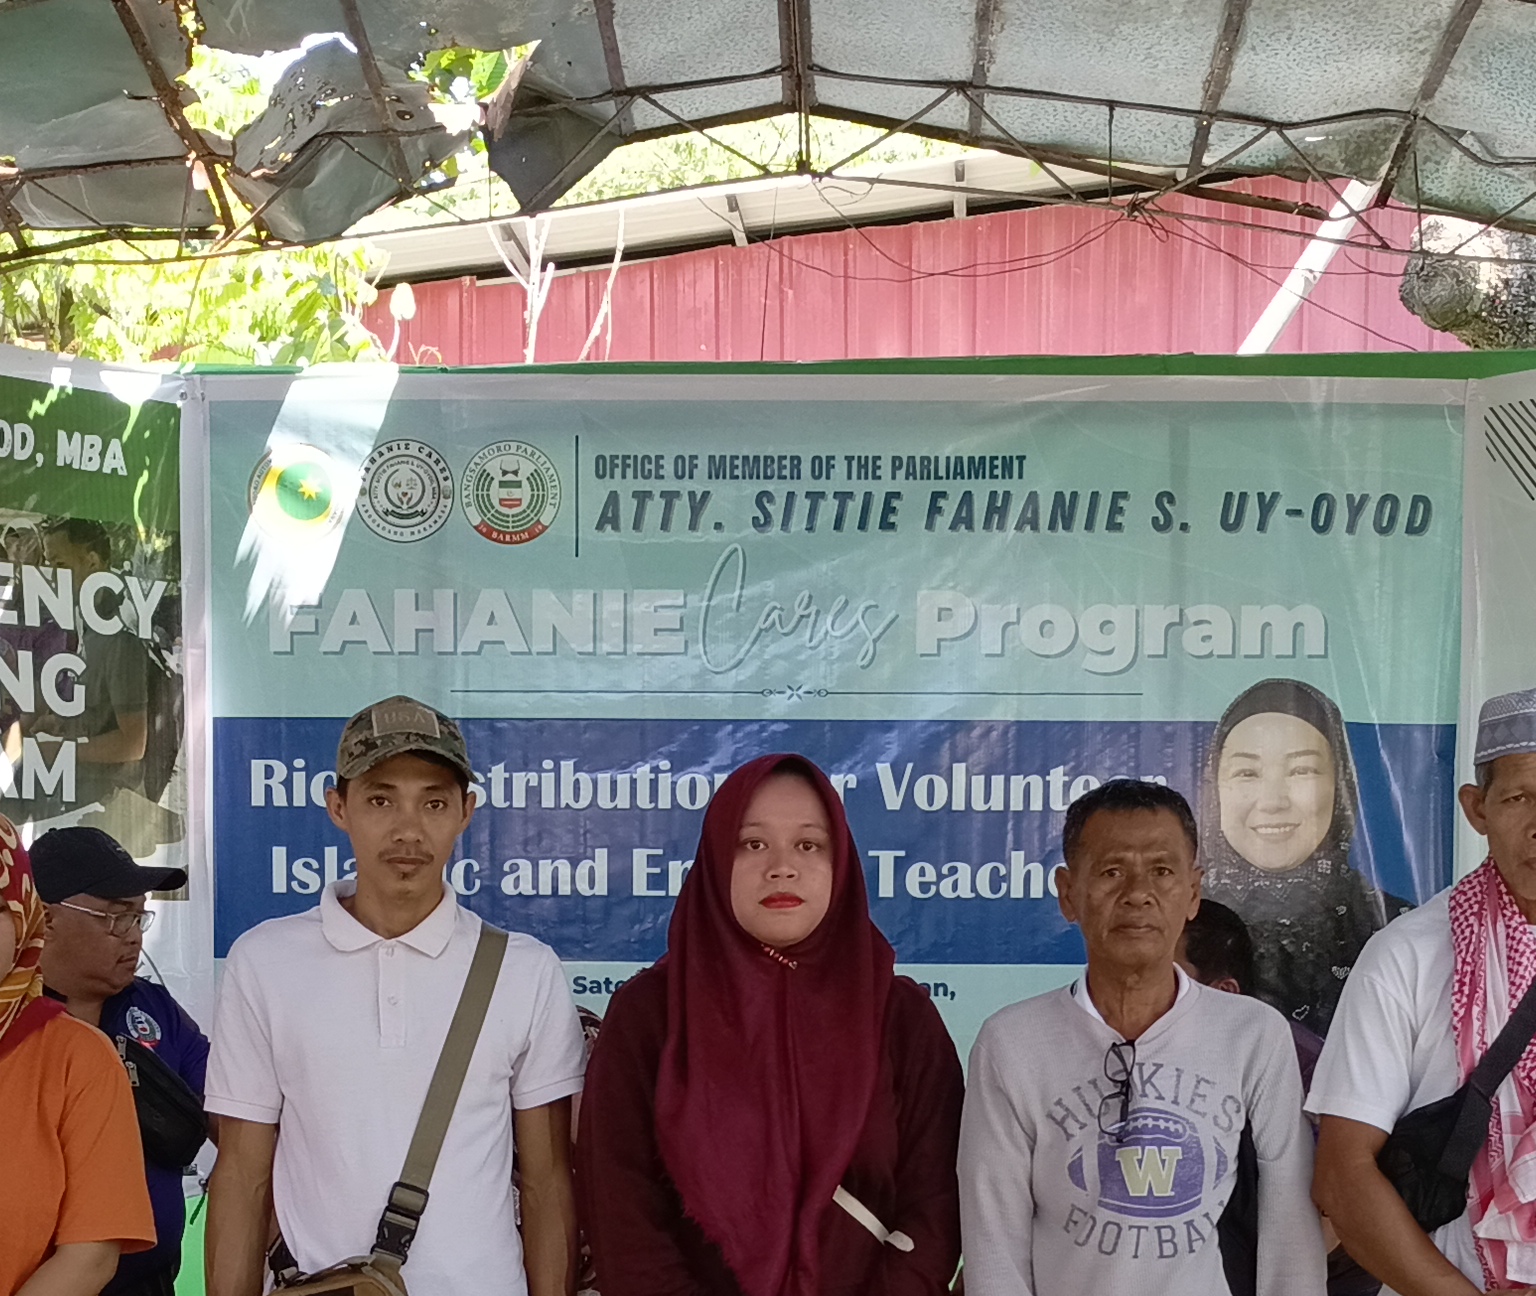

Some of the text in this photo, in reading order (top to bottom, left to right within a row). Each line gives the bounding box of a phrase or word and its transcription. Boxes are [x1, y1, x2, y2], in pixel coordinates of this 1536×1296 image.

[55, 429, 128, 477] MBA
[464, 443, 512, 509] BANGSAMORO
[515, 444, 558, 509] PARLIAMENT
[594, 454, 1027, 481] OFFICE OF MEMBER OF THE PARLIAMENT
[491, 530, 530, 542] BARMM
[595, 489, 1434, 537] ATTY. SITTIE FAHANIE S. UY-OYOD
[268, 543, 1330, 676] FAHANIE Cares Program
[501, 846, 609, 897] and
[1115, 1145, 1183, 1197] W
